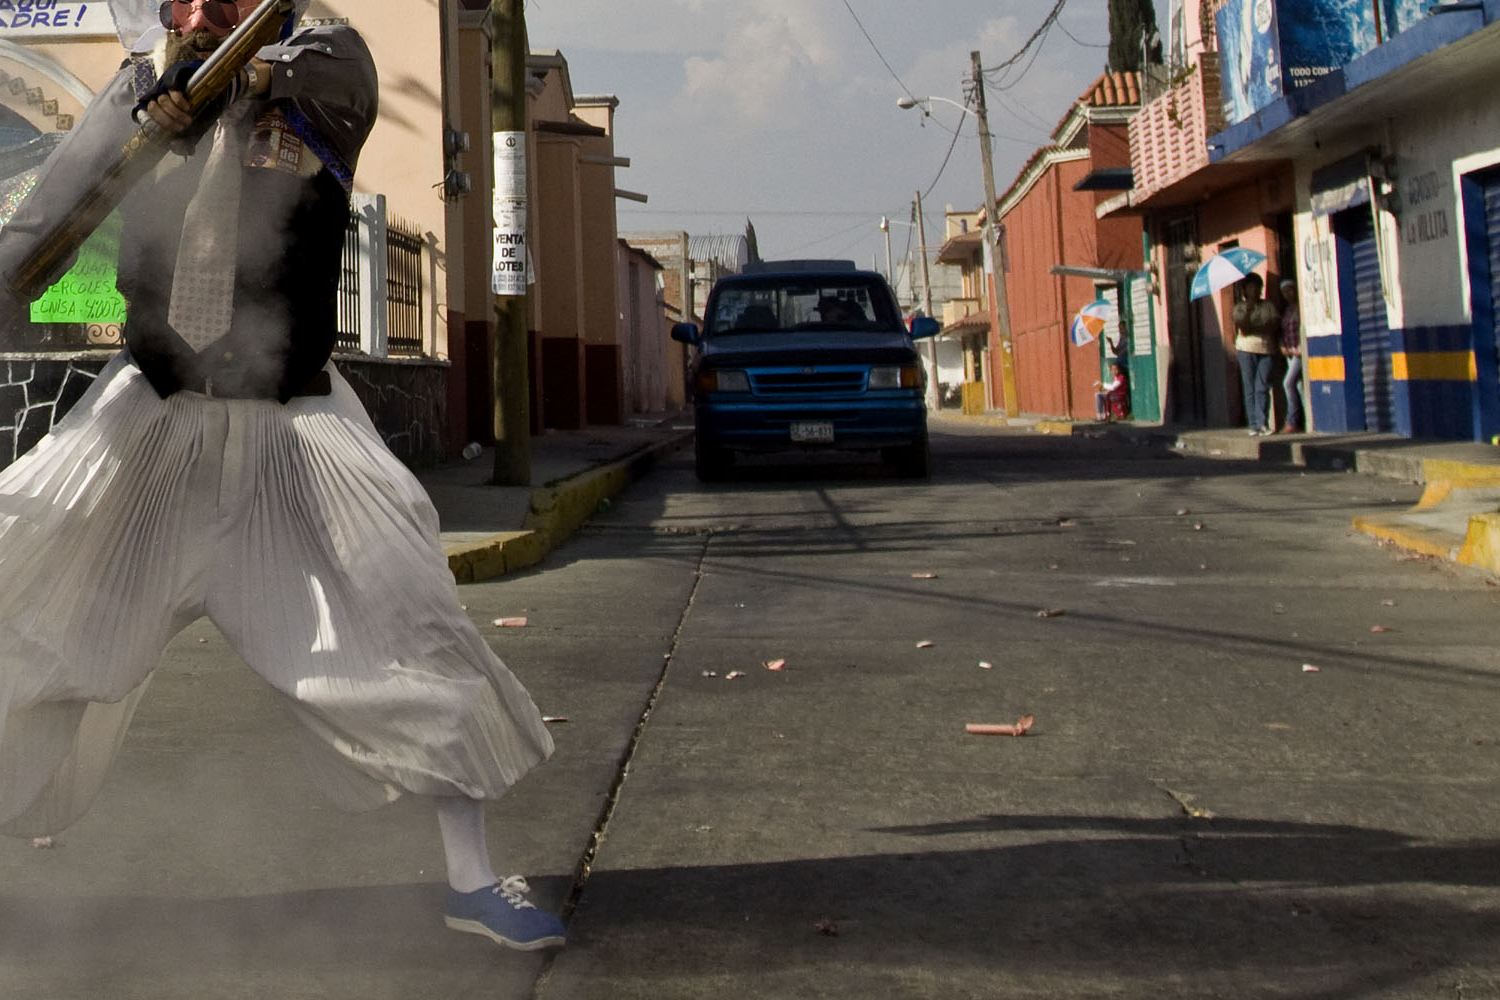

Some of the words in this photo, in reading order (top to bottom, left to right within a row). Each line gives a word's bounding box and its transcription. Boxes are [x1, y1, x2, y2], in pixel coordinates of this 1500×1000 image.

[280, 149, 299, 164] del
[496, 233, 524, 245] VENTA
[502, 248, 516, 258] DE
[495, 261, 524, 272] LOTES
